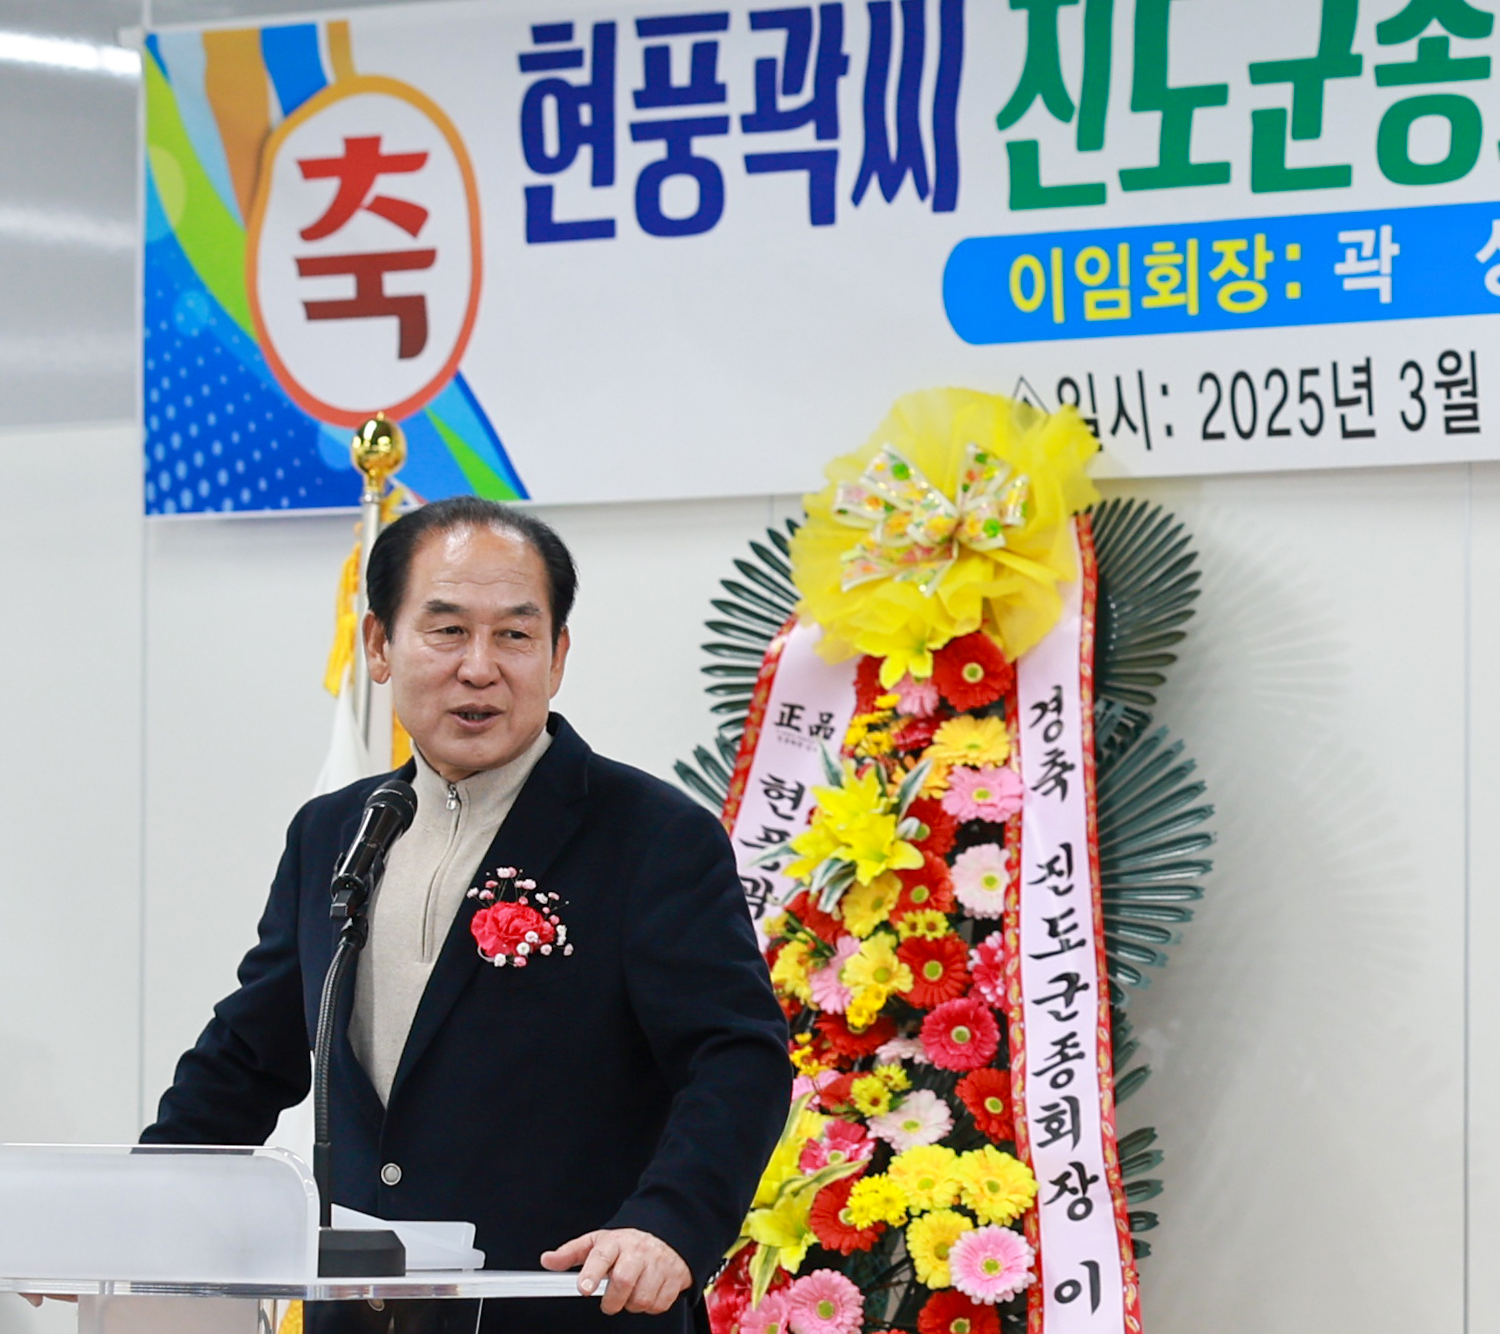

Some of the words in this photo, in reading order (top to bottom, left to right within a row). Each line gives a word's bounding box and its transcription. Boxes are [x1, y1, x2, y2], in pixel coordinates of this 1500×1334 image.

[294, 134, 438, 362] 축
[1007, 231, 1303, 326] 이임회장:
[1332, 223, 1401, 304] 곽
[1198, 356, 1375, 442] 2025년
[1399, 349, 1482, 436] 3월
[1026, 685, 1076, 802] 경축
[1026, 842, 1101, 1223] 진도군종회장
